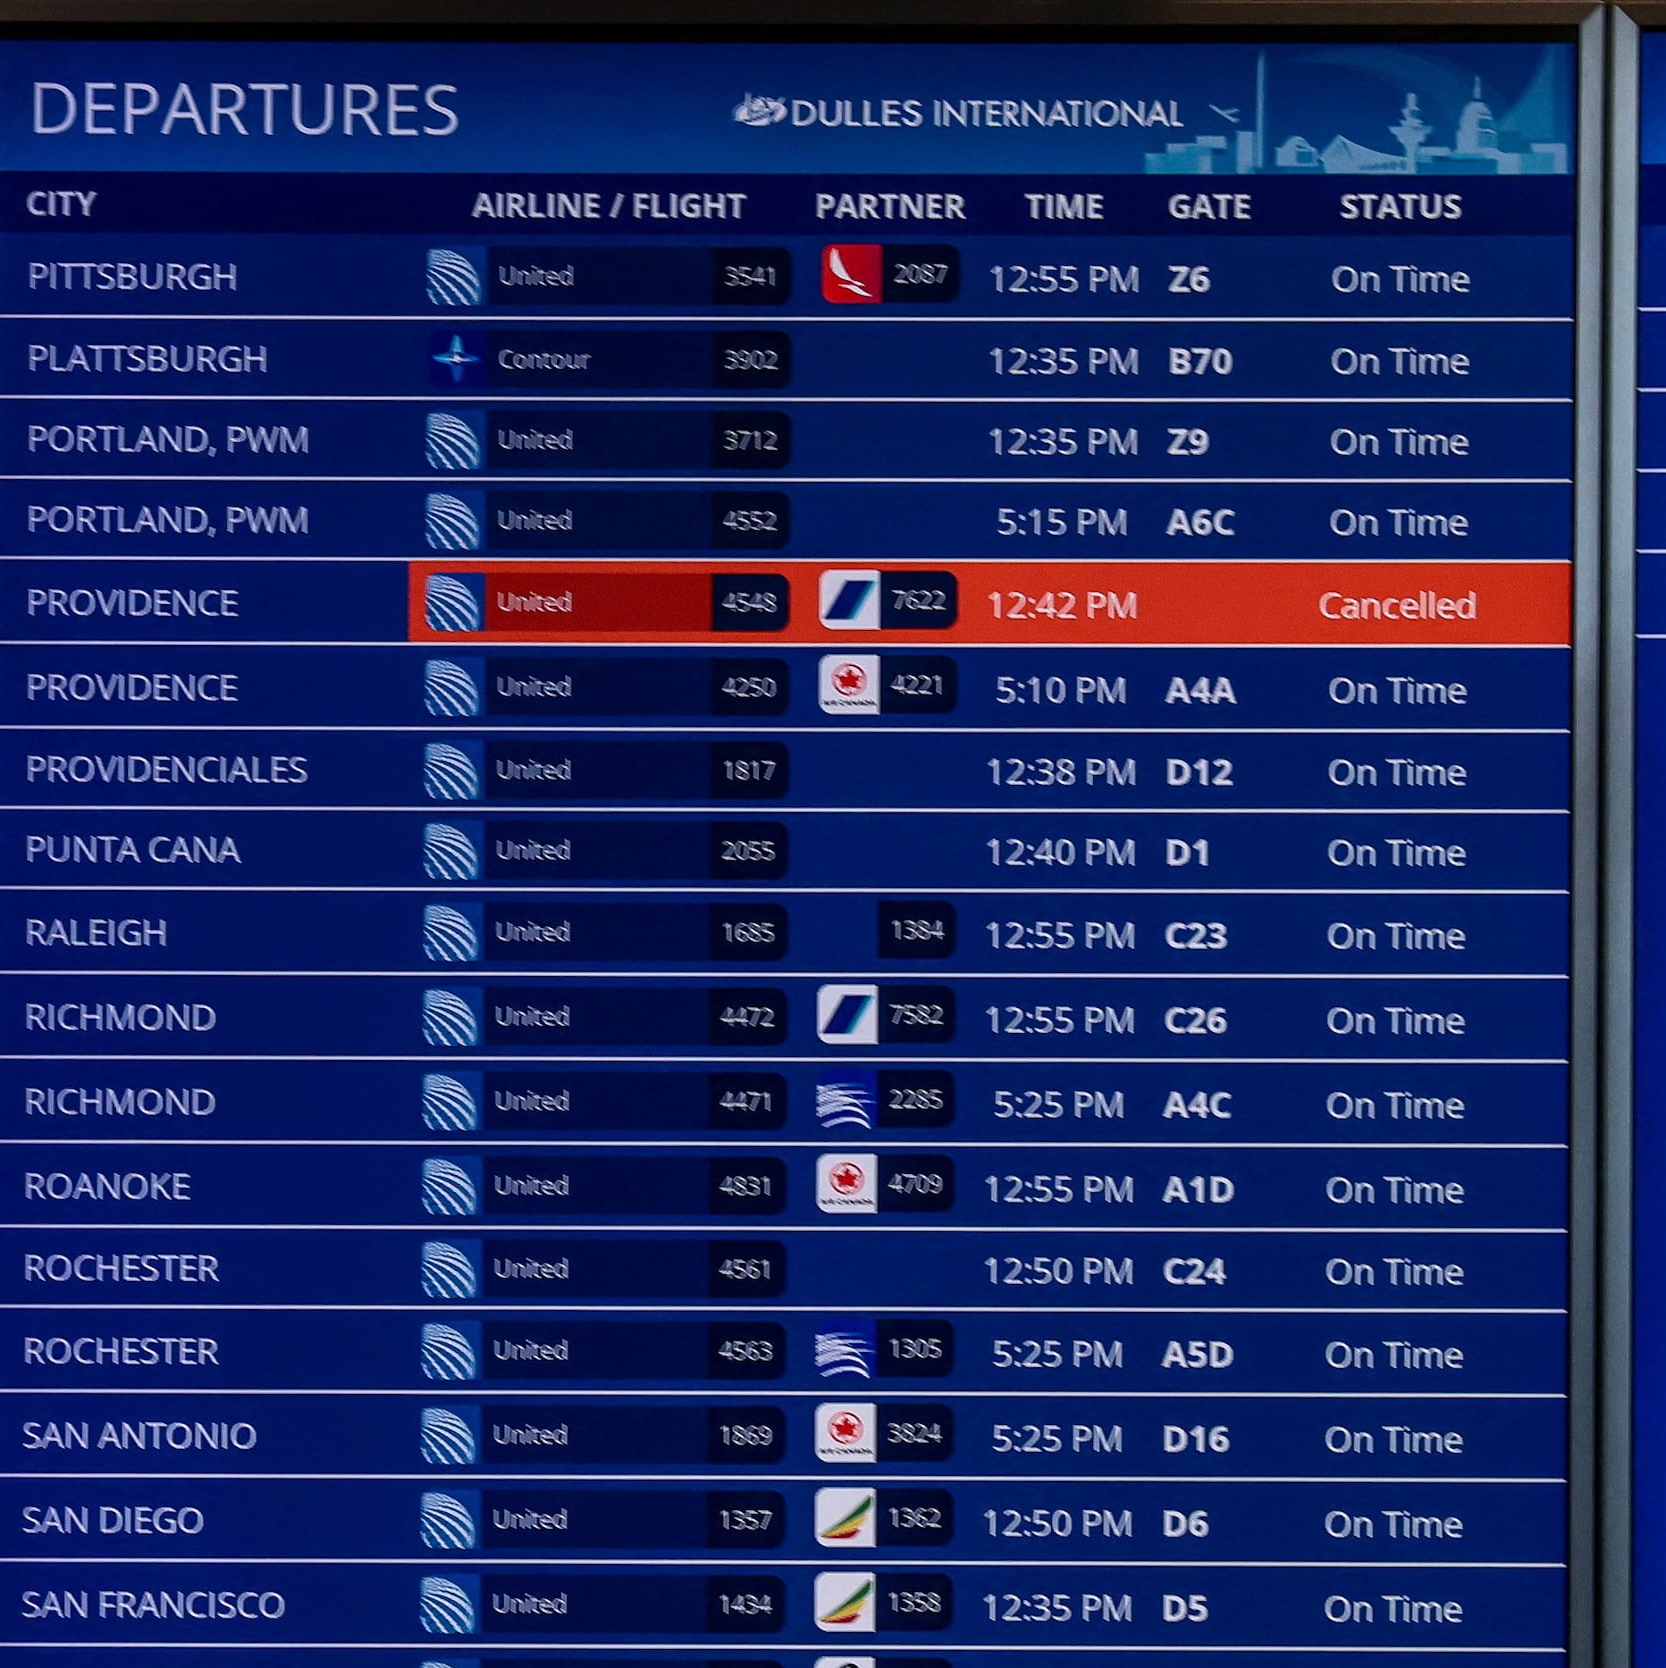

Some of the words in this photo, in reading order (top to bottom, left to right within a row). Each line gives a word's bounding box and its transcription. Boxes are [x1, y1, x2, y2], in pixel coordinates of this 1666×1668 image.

[34, 82, 458, 136] DEPARTURES
[792, 101, 924, 128] DULLES
[934, 100, 1184, 127] INTERNATIONAL
[27, 191, 97, 216] CITY
[472, 193, 600, 219] AIRLINE
[609, 193, 625, 219] /
[633, 193, 747, 219] FLIGHT
[816, 193, 967, 219] PARTNER
[1024, 194, 1104, 219] TIME
[1169, 194, 1251, 219] GATE
[1340, 193, 1462, 219] STATUS
[28, 589, 239, 616] PROVIDENCE
[498, 591, 572, 612] United
[988, 592, 1077, 620] 12:42
[1087, 592, 1137, 620] PM
[1319, 588, 1476, 624] Cancelled
